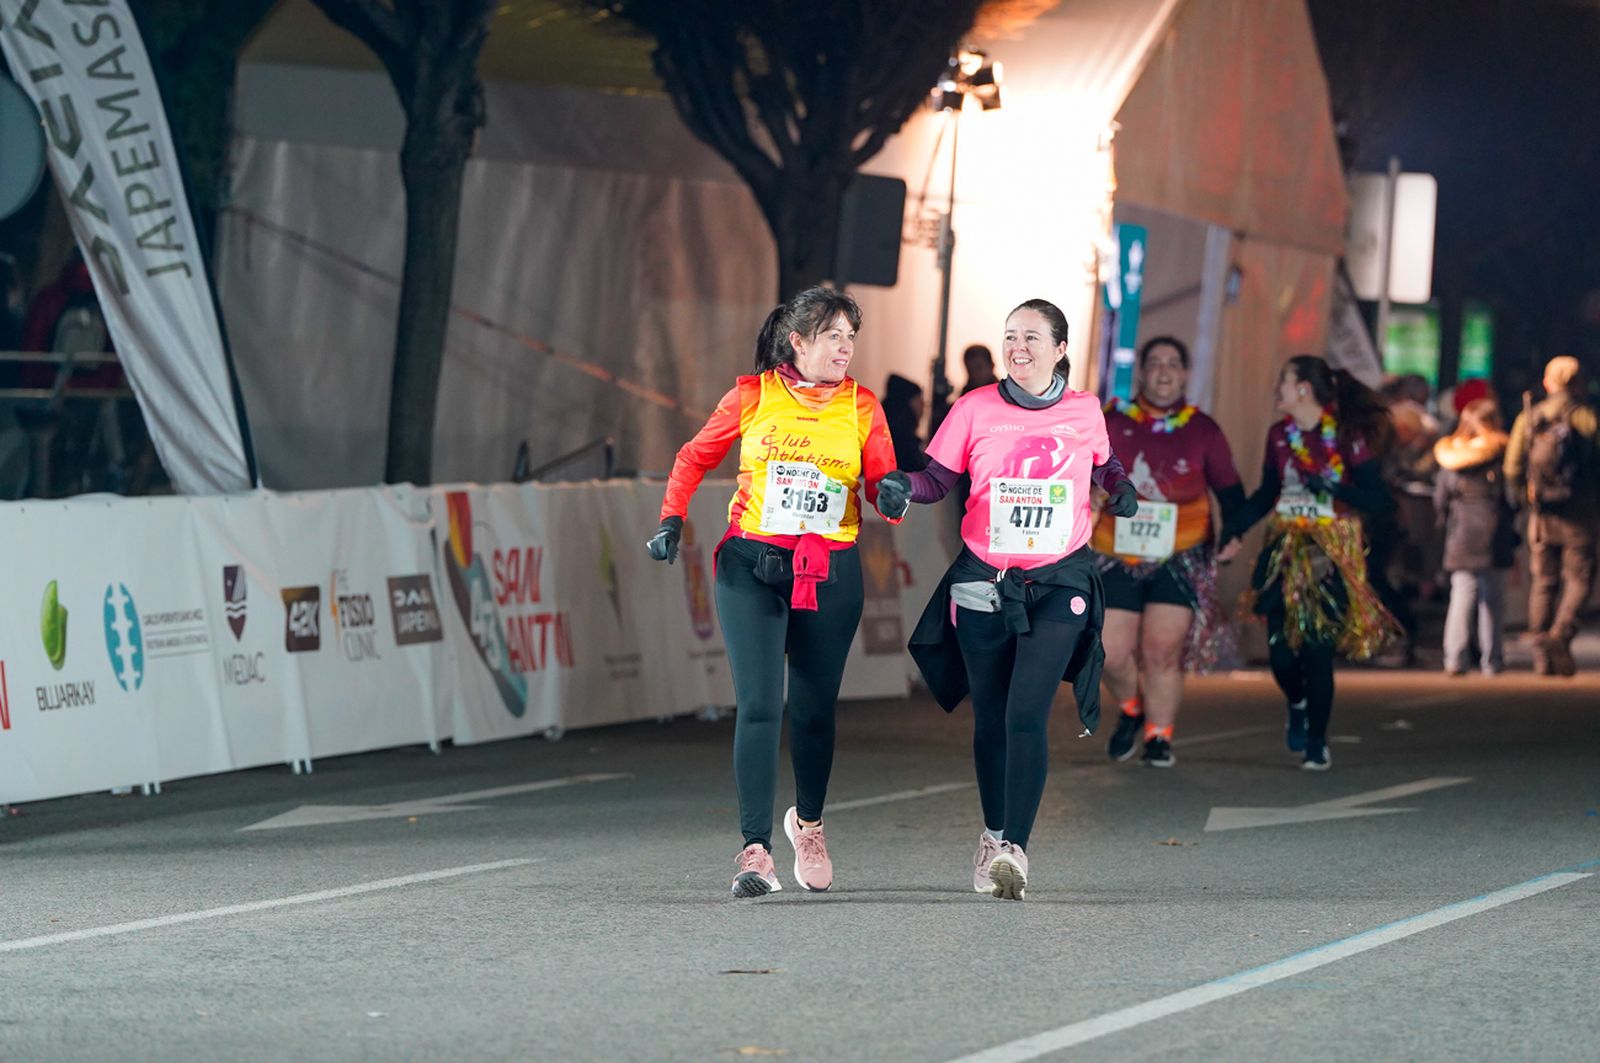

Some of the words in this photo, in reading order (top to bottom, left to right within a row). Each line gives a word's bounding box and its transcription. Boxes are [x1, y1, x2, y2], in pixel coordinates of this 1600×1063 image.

[62, 0, 193, 279] JAPEMAS
[990, 424, 1025, 432] OYSHO
[761, 433, 811, 448] Club
[776, 477, 793, 486] SAN
[810, 472, 821, 481] DE
[781, 487, 829, 513] 3153
[999, 495, 1015, 504] SAN
[1008, 487, 1031, 495] NOCHE
[1033, 488, 1043, 496] DE
[1009, 506, 1053, 528] 4777
[1130, 521, 1161, 538] 1272
[493, 546, 543, 606] SAN
[289, 600, 319, 638] 42K
[223, 652, 267, 685] MEDAC
